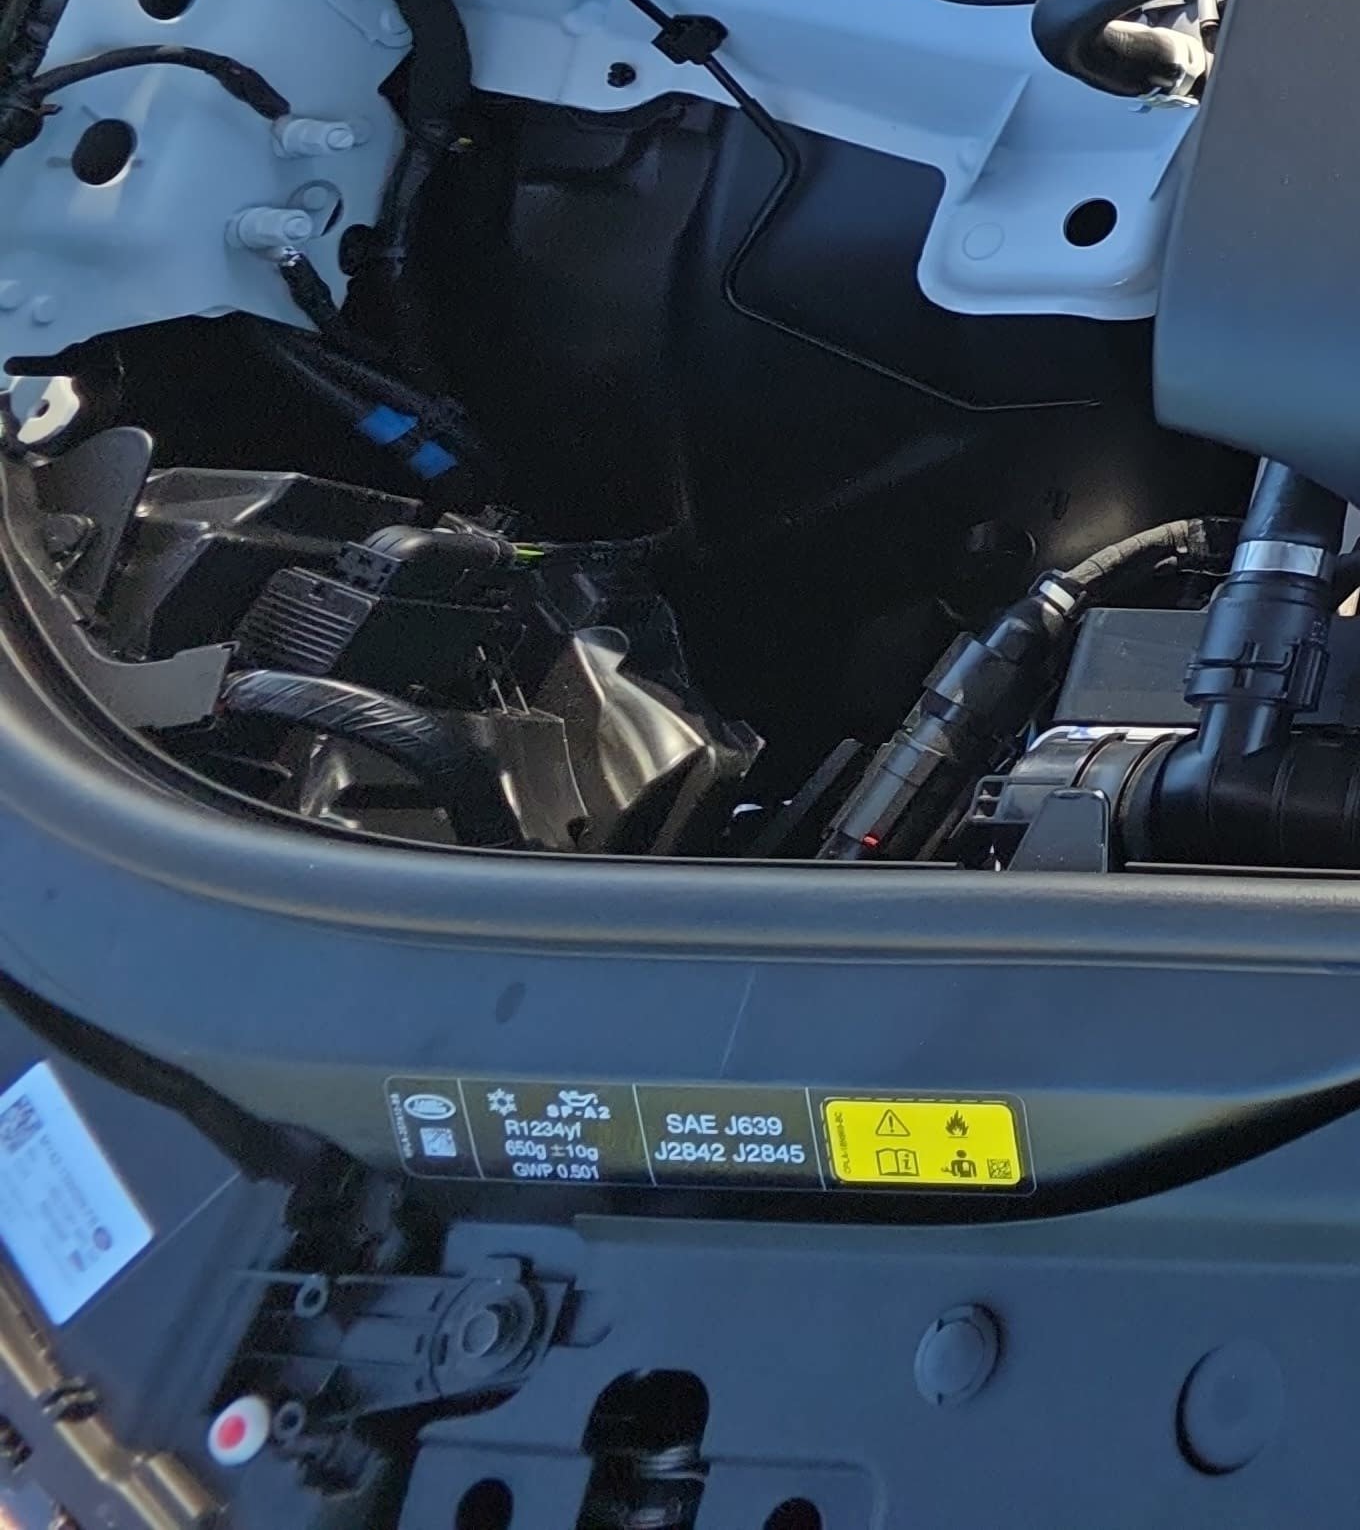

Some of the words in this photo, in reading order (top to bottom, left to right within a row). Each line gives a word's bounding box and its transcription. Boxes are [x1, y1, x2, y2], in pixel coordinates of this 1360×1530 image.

[546, 1104, 611, 1120] SP-A2
[504, 1119, 581, 1141] R1234yf
[666, 1113, 717, 1135] SAE
[724, 1115, 783, 1136] J639
[505, 1139, 547, 1160] 650g
[654, 1141, 725, 1163] J2842
[733, 1142, 805, 1164] J2845
[512, 1161, 553, 1177] GWP
[557, 1163, 600, 1180] 0.501
